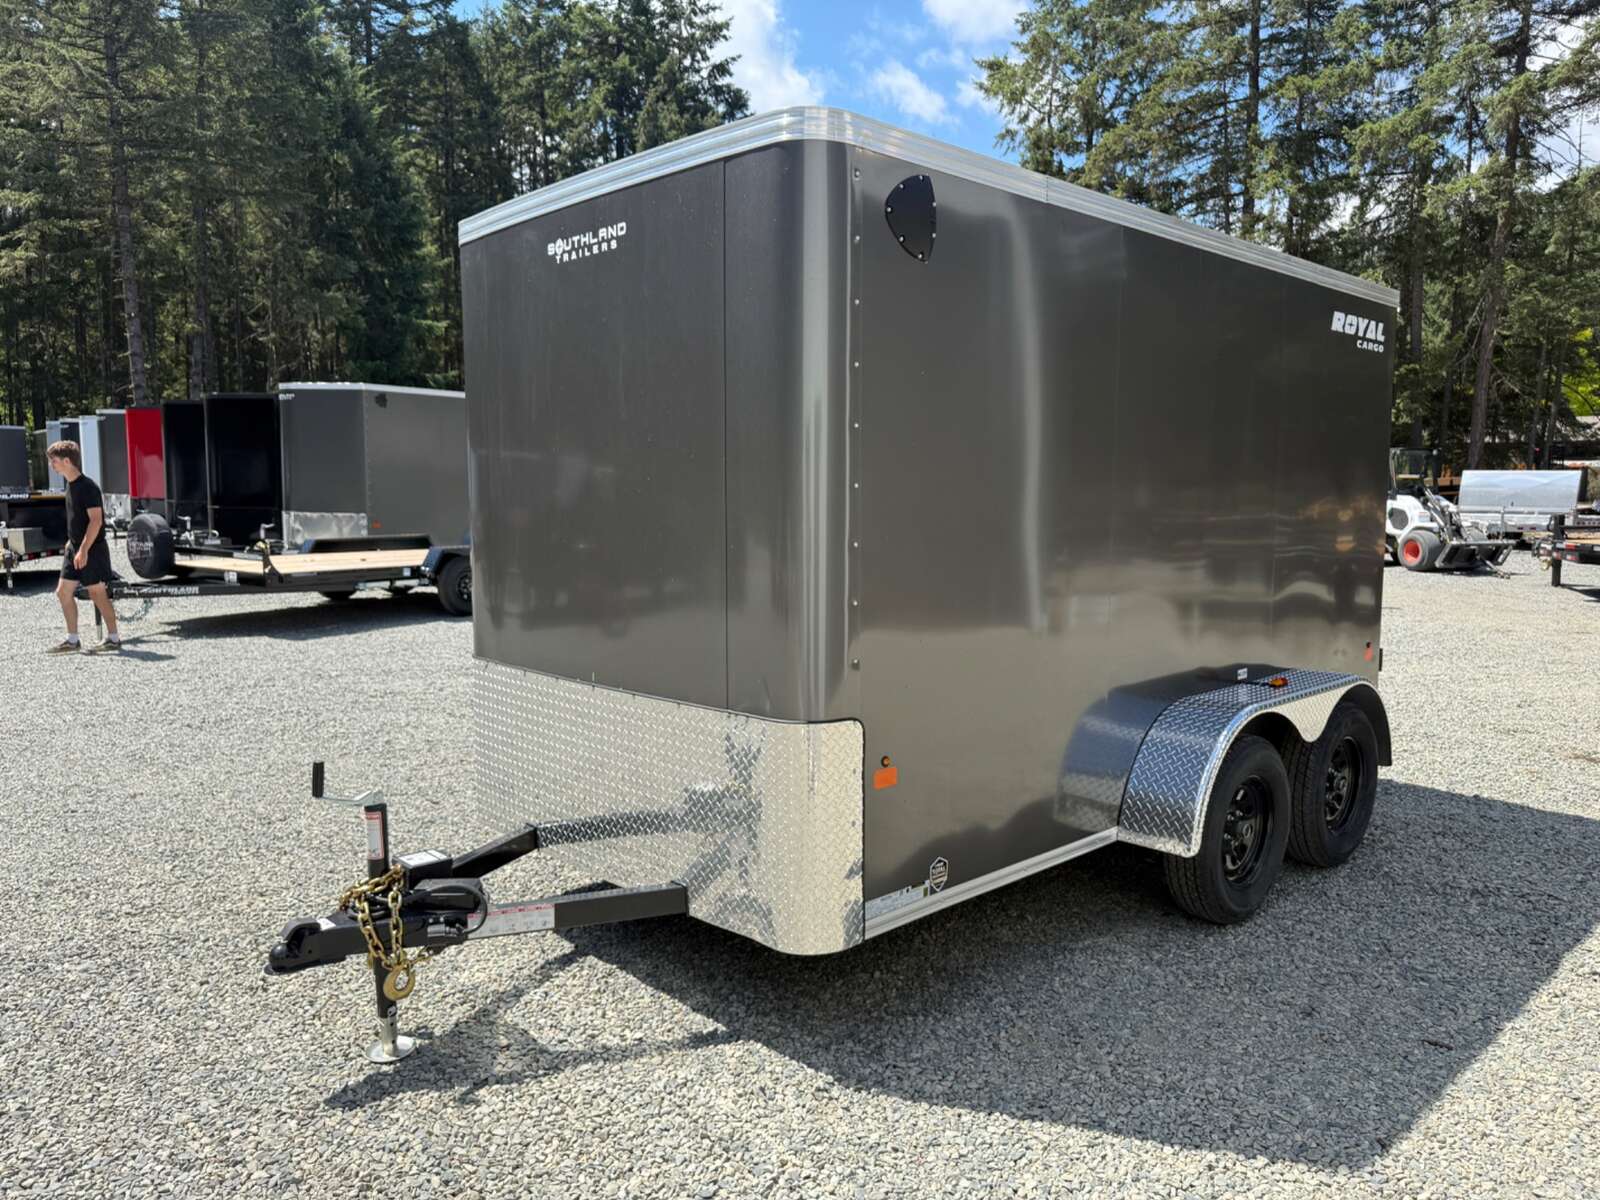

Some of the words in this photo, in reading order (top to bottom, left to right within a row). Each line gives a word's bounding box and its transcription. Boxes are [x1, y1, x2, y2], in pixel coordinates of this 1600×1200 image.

[547, 222, 626, 255] SOUTHLAND
[555, 239, 617, 264] TRAILERS
[1331, 310, 1385, 342] ROYAL
[1356, 340, 1384, 353] CARGO
